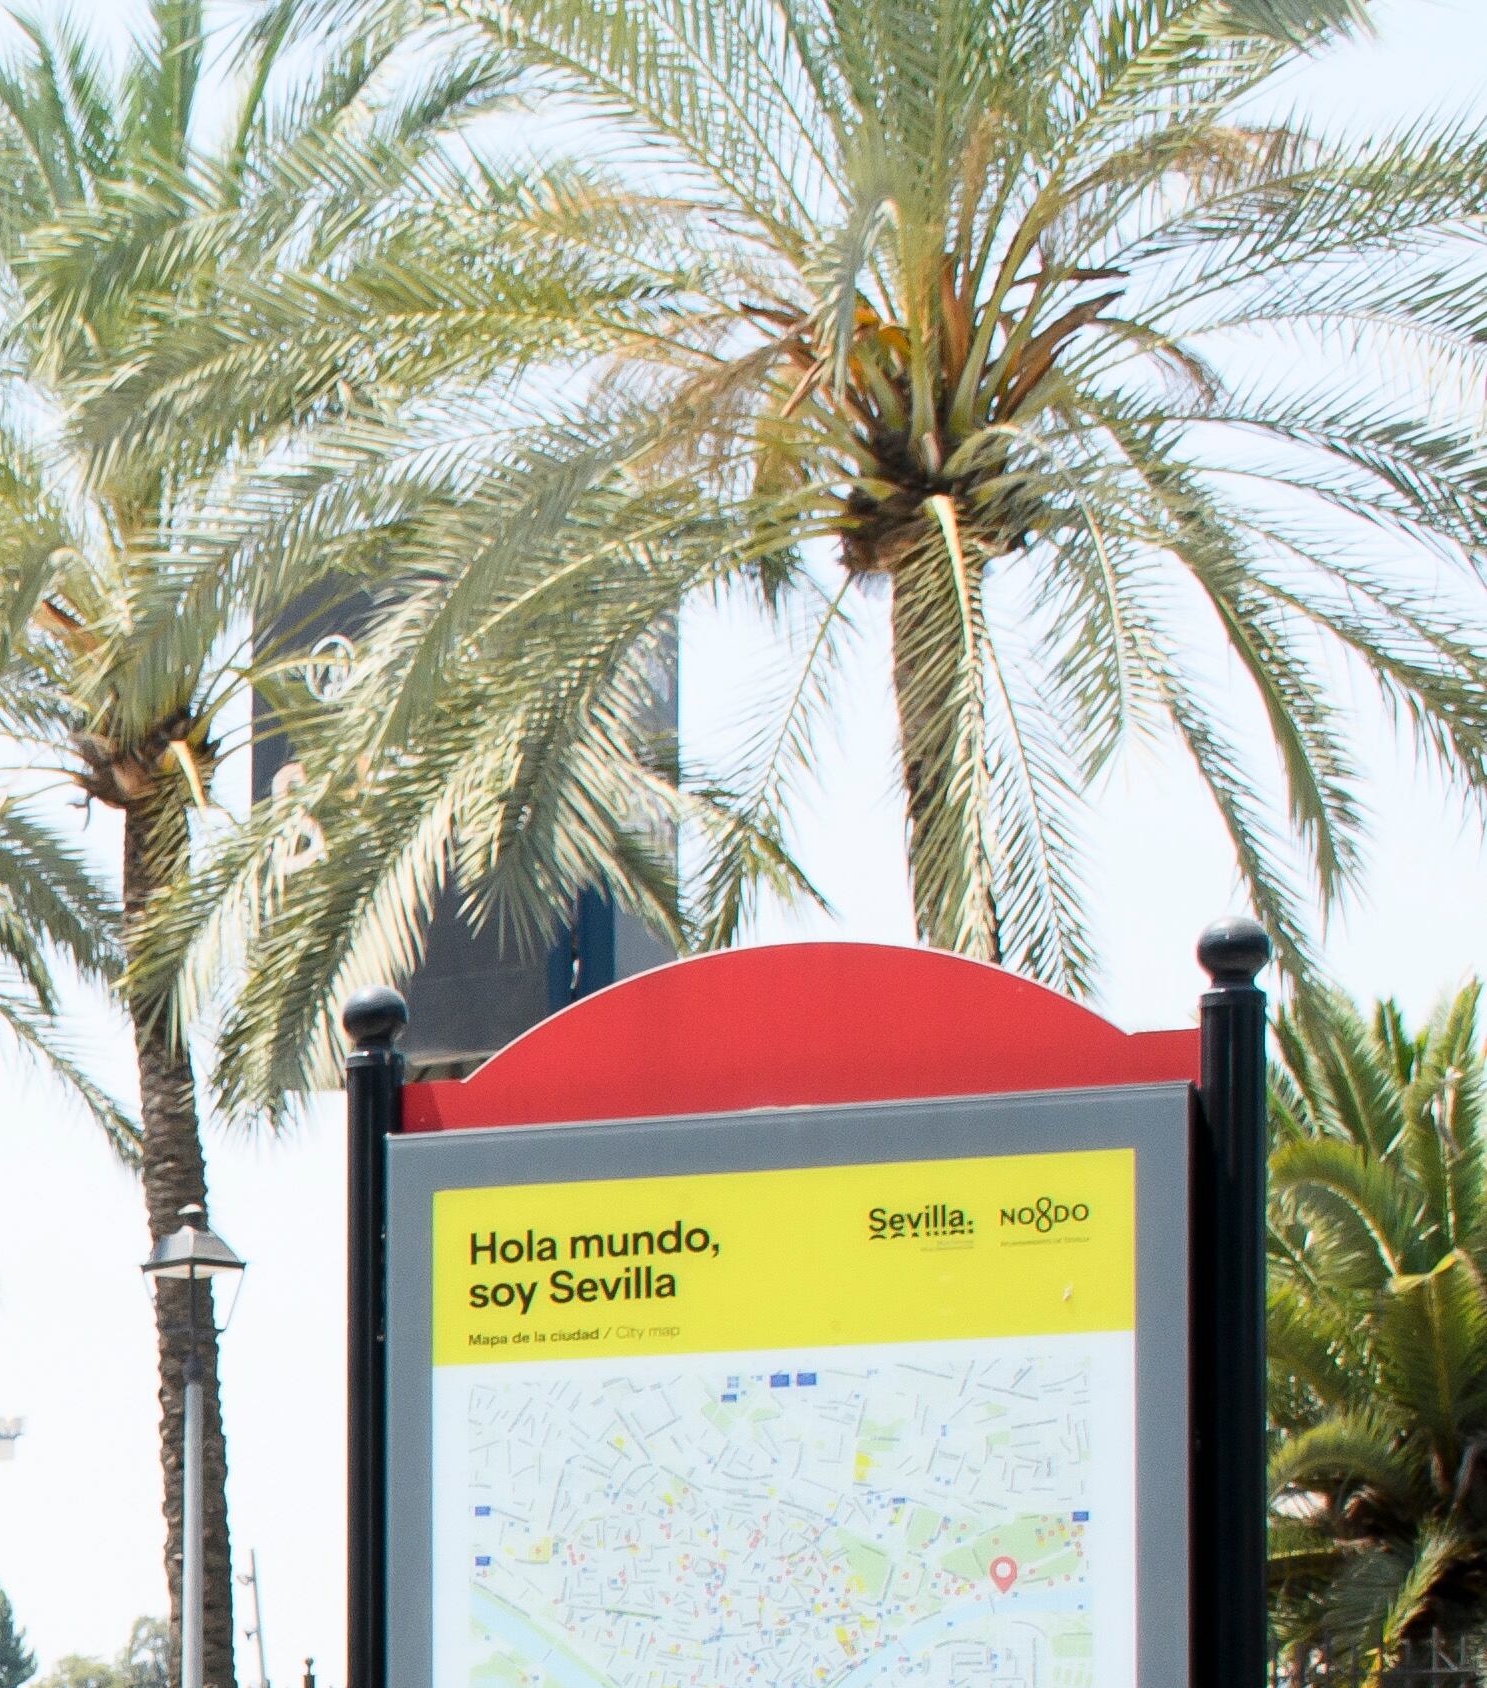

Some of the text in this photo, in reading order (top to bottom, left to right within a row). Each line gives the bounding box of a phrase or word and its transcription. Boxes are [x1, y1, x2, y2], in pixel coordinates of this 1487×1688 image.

[470, 1220, 720, 1265] Hola mundo,
[469, 1265, 677, 1315] soy Sevilla
[468, 1333, 508, 1348] Mapa
[512, 1332, 530, 1344] de
[534, 1331, 546, 1343] la
[550, 1328, 600, 1342] ciudad
[615, 1327, 644, 1341] City
[648, 1326, 680, 1341] map
